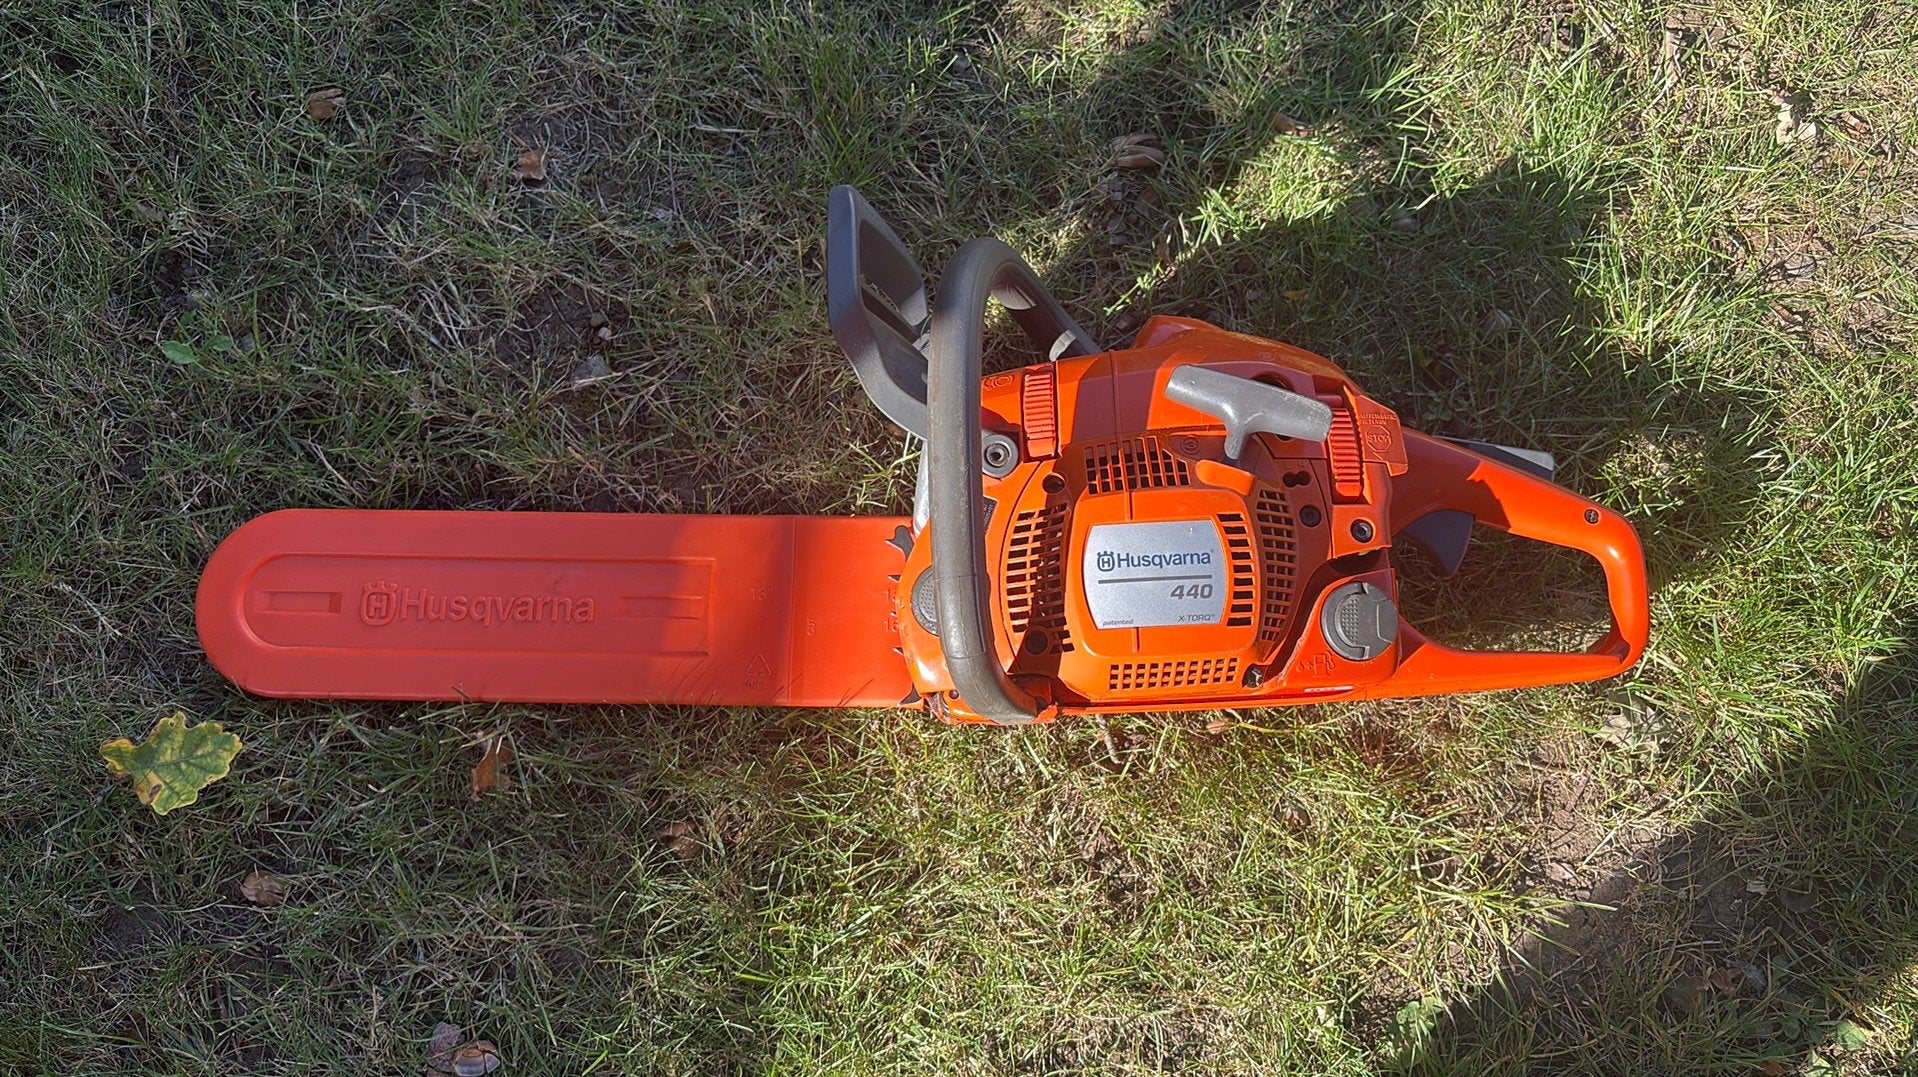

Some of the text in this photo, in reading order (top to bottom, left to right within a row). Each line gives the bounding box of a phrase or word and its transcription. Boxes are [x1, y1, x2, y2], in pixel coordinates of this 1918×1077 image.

[1367, 434, 1390, 443] STOP
[1117, 552, 1212, 569] Husqvarna
[1170, 584, 1213, 600] 440
[402, 587, 595, 627] Husqvarna
[1102, 618, 1134, 627] patented
[1177, 613, 1212, 623] X-TORQ
